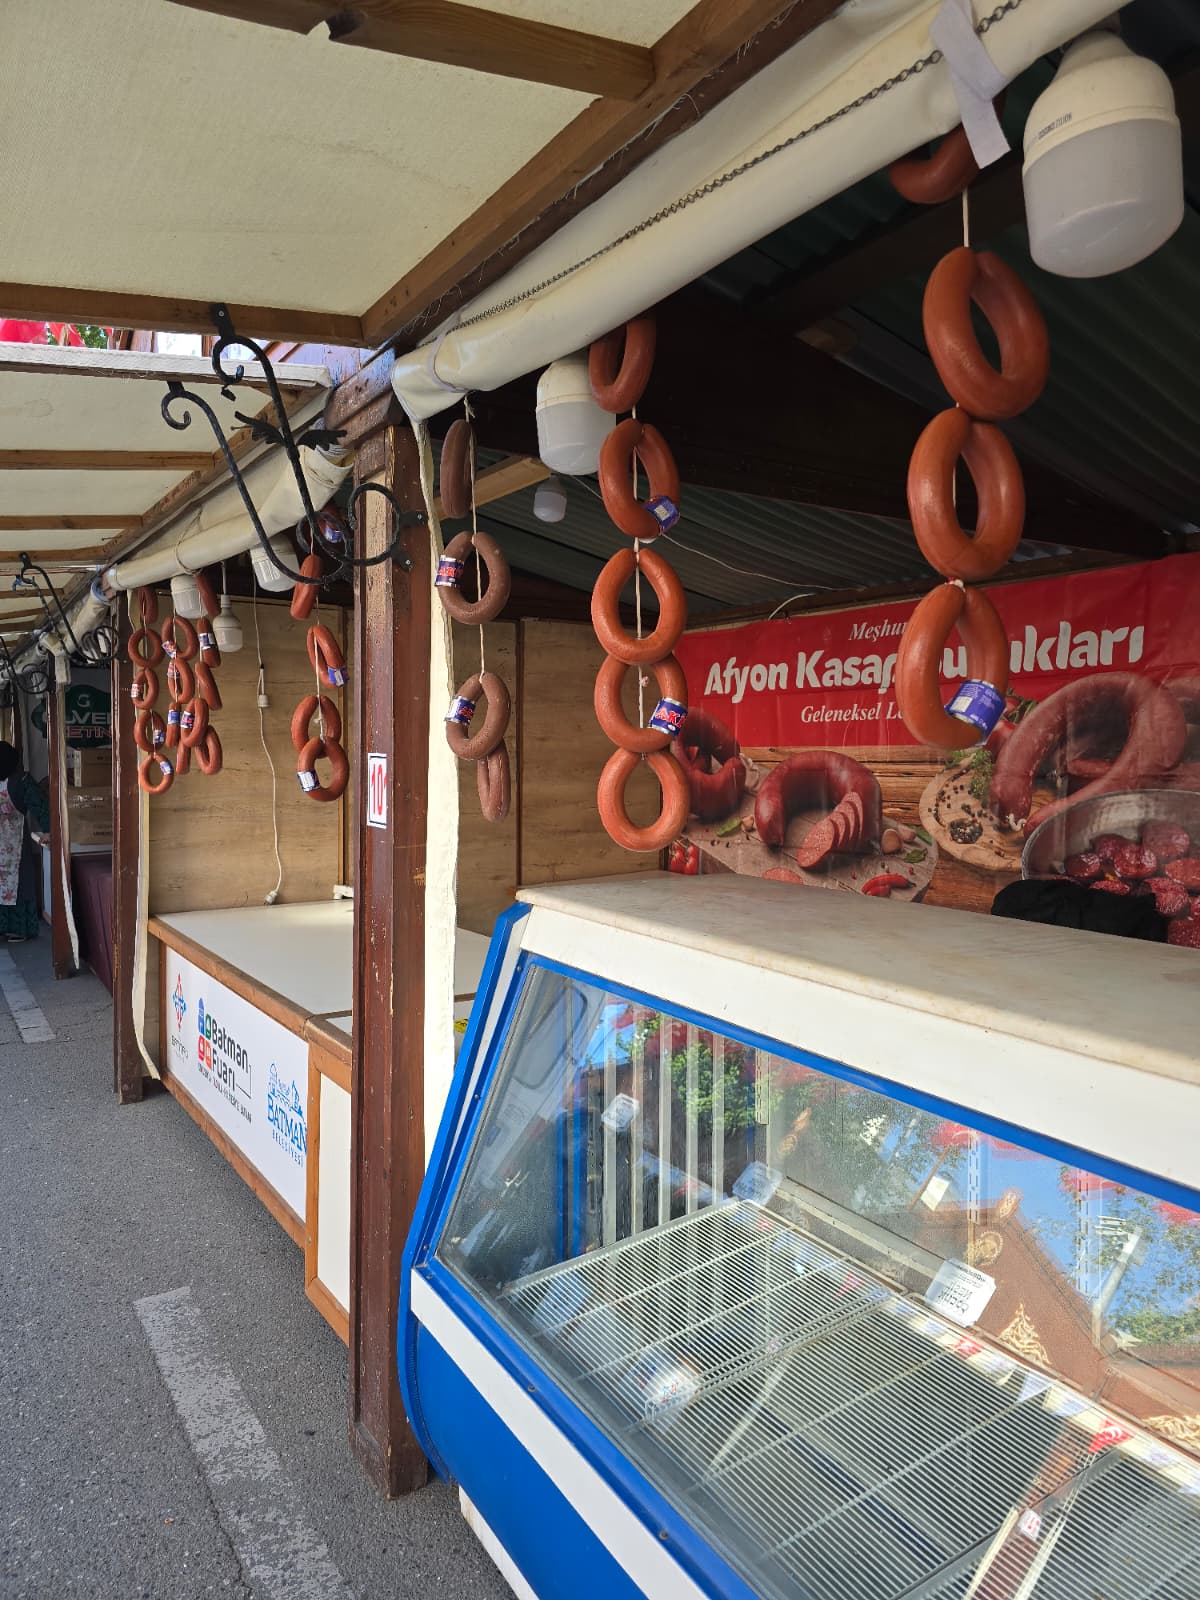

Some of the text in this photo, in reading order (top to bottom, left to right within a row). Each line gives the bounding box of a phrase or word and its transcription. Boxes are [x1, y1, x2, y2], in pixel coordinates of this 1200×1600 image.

[704, 656, 788, 704] Afyon
[801, 702, 882, 723] Geleneksel
[212, 1018, 249, 1073] Batman
[212, 1047, 235, 1090] Fuarı
[267, 1094, 307, 1154] BATMAN
